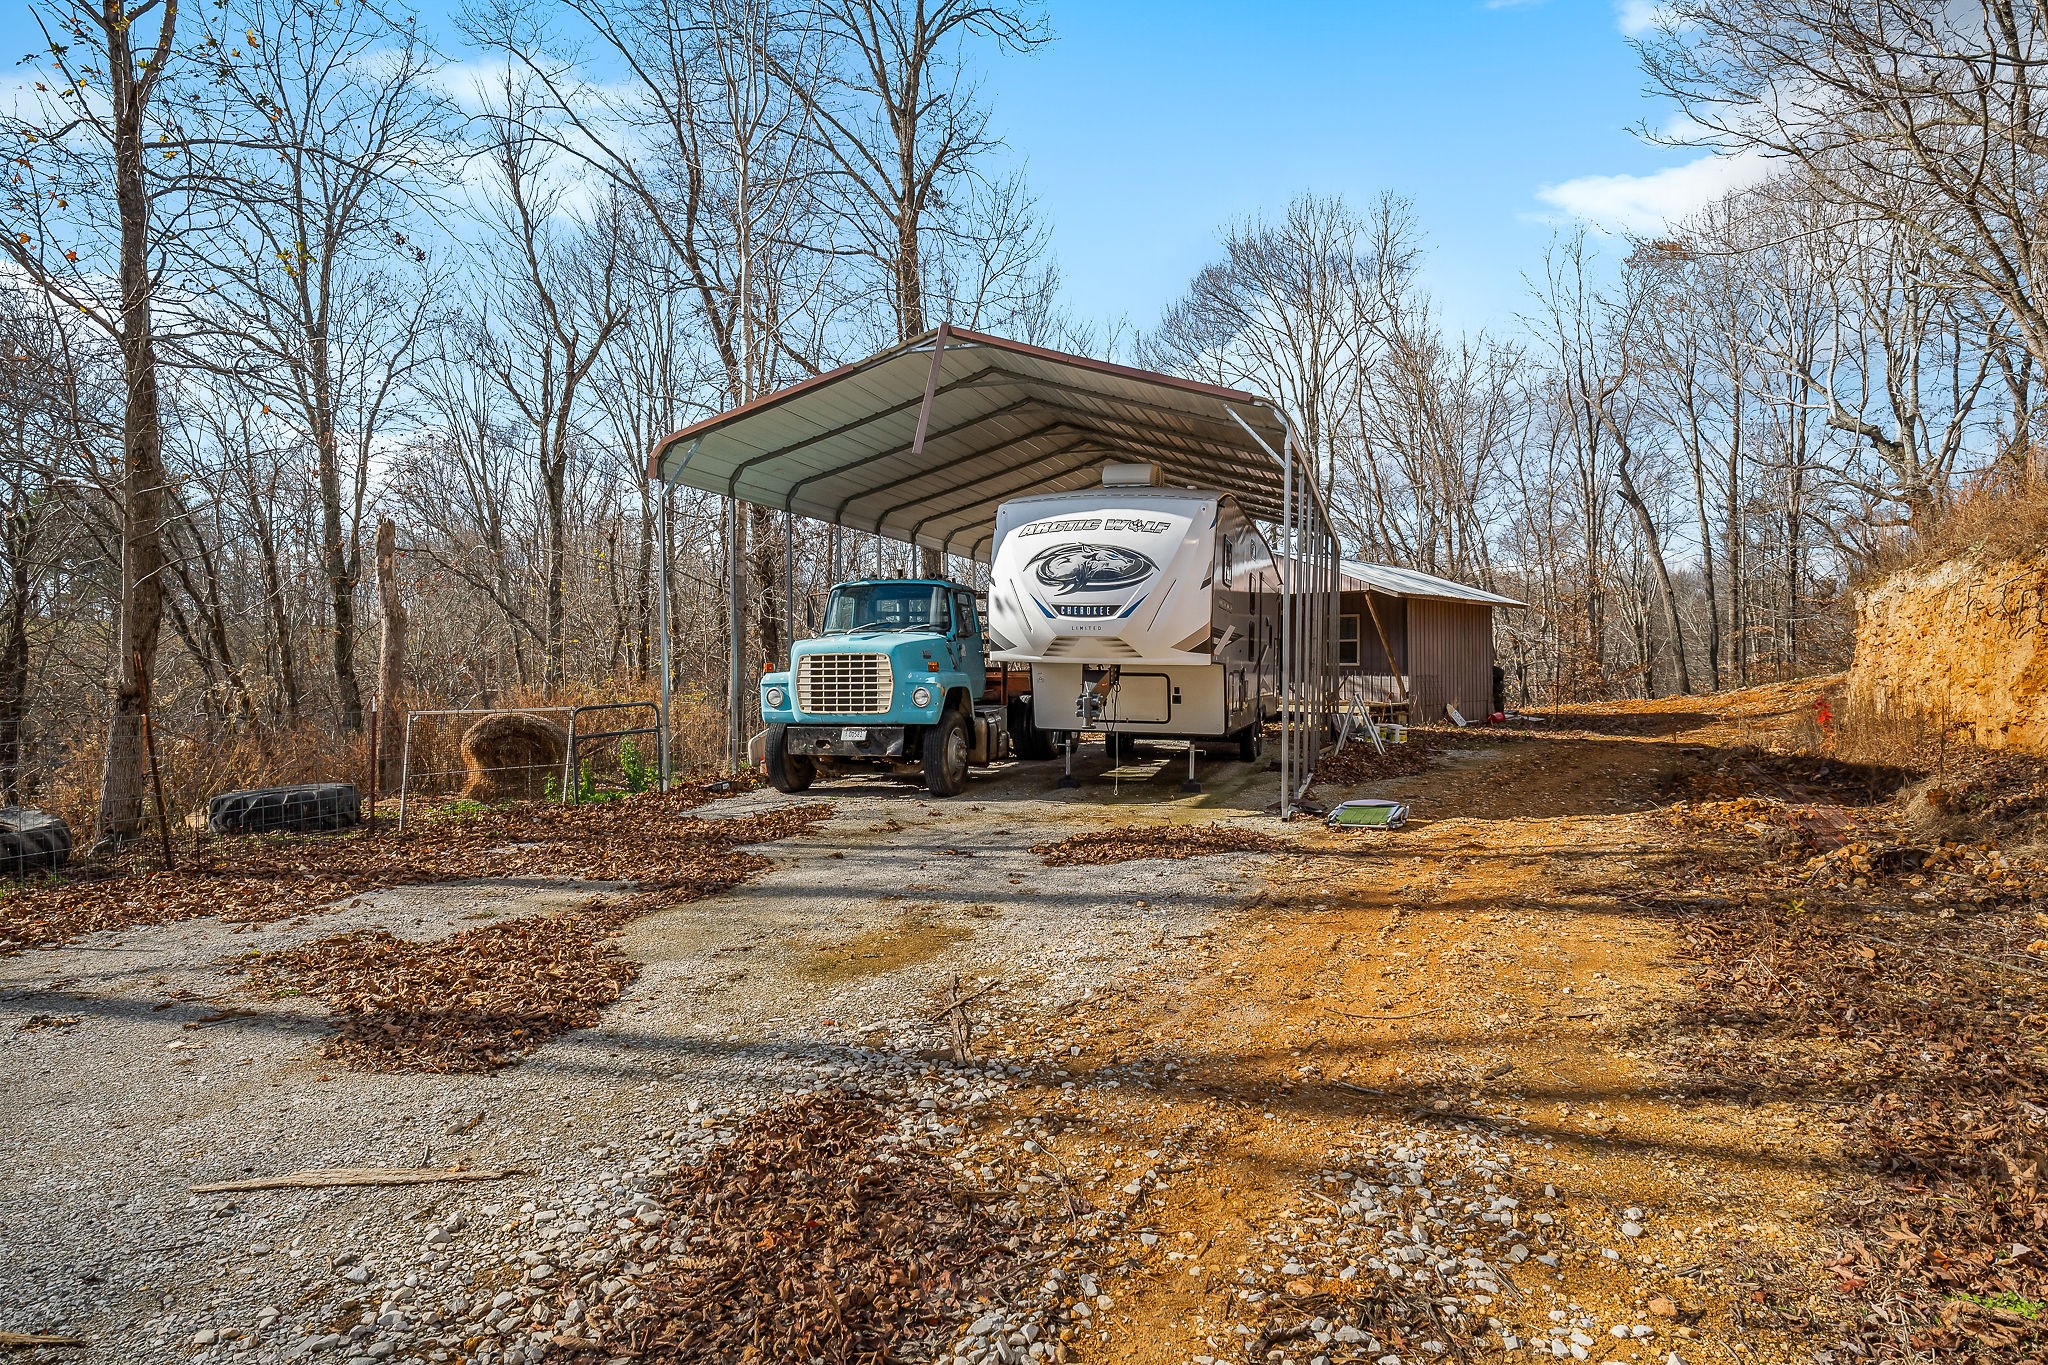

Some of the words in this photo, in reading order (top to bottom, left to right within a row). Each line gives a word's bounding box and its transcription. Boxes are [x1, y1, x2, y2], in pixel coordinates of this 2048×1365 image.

[1018, 519, 1102, 538] ARCTIC
[1104, 518, 1171, 534] WOLF
[1060, 606, 1110, 616] CHEROKEE
